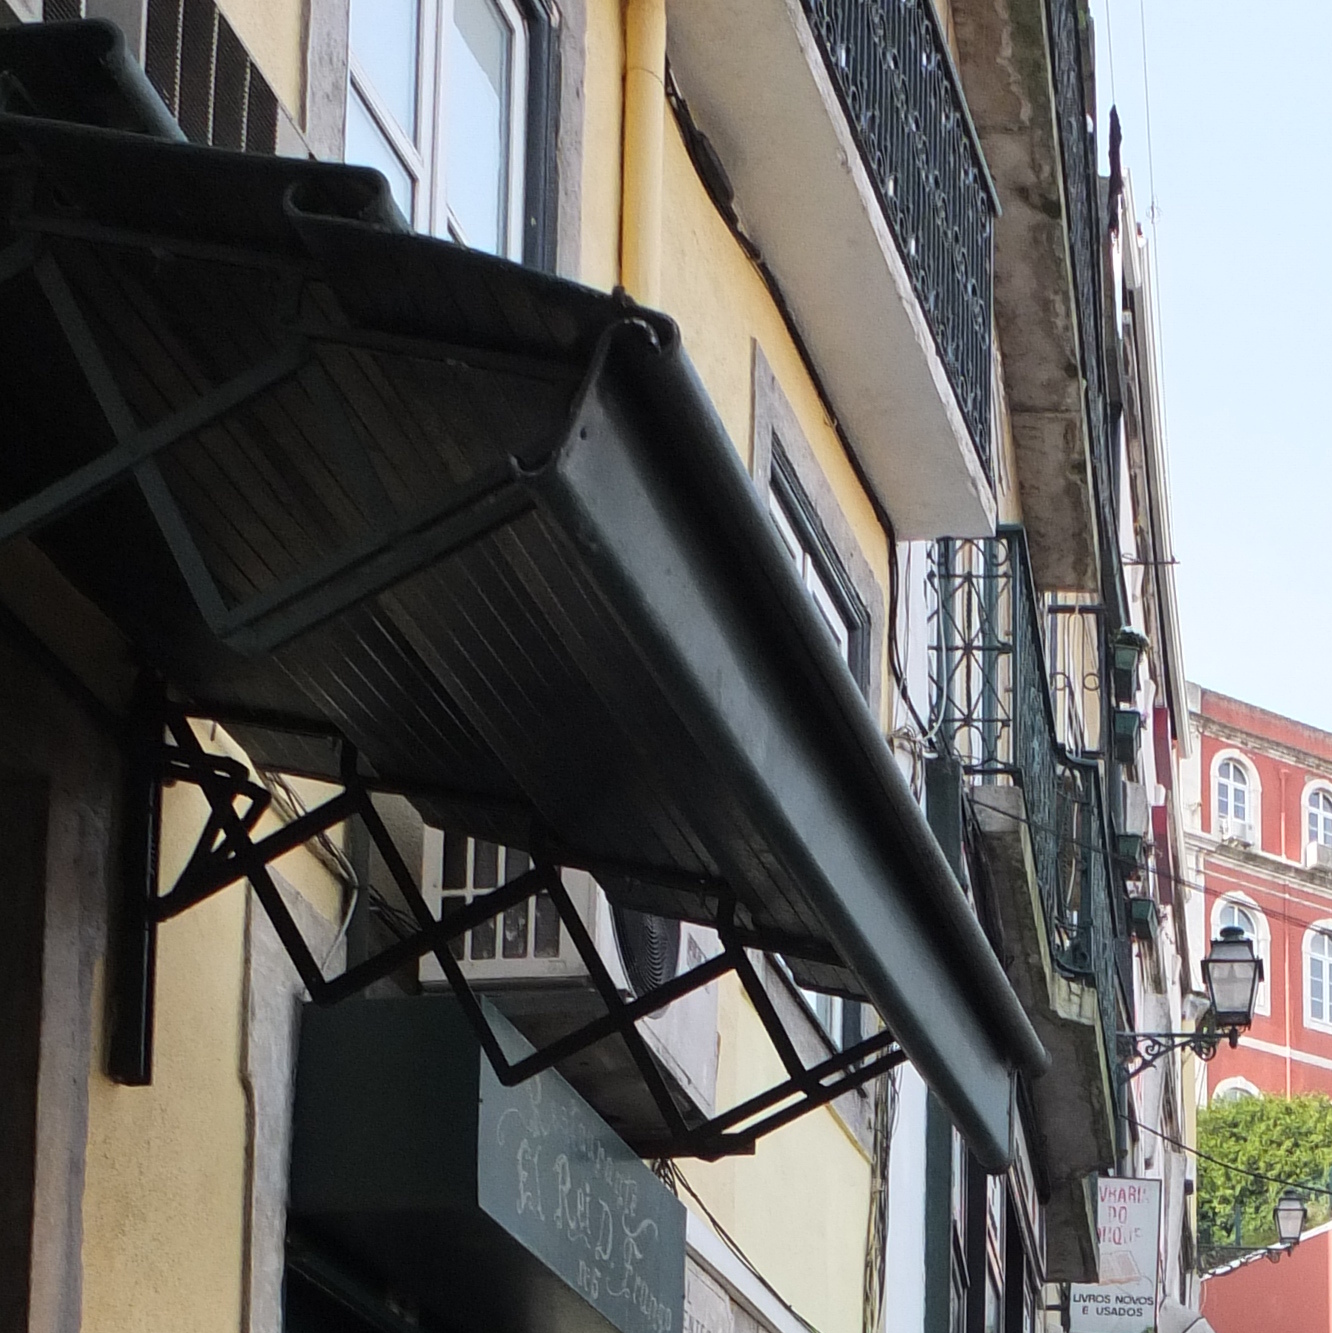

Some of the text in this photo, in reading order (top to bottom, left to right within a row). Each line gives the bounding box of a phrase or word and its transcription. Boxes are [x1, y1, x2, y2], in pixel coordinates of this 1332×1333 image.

[1072, 1293, 1154, 1306] LIVROS NOVOS
[1081, 1305, 1144, 1318] E USADOS
